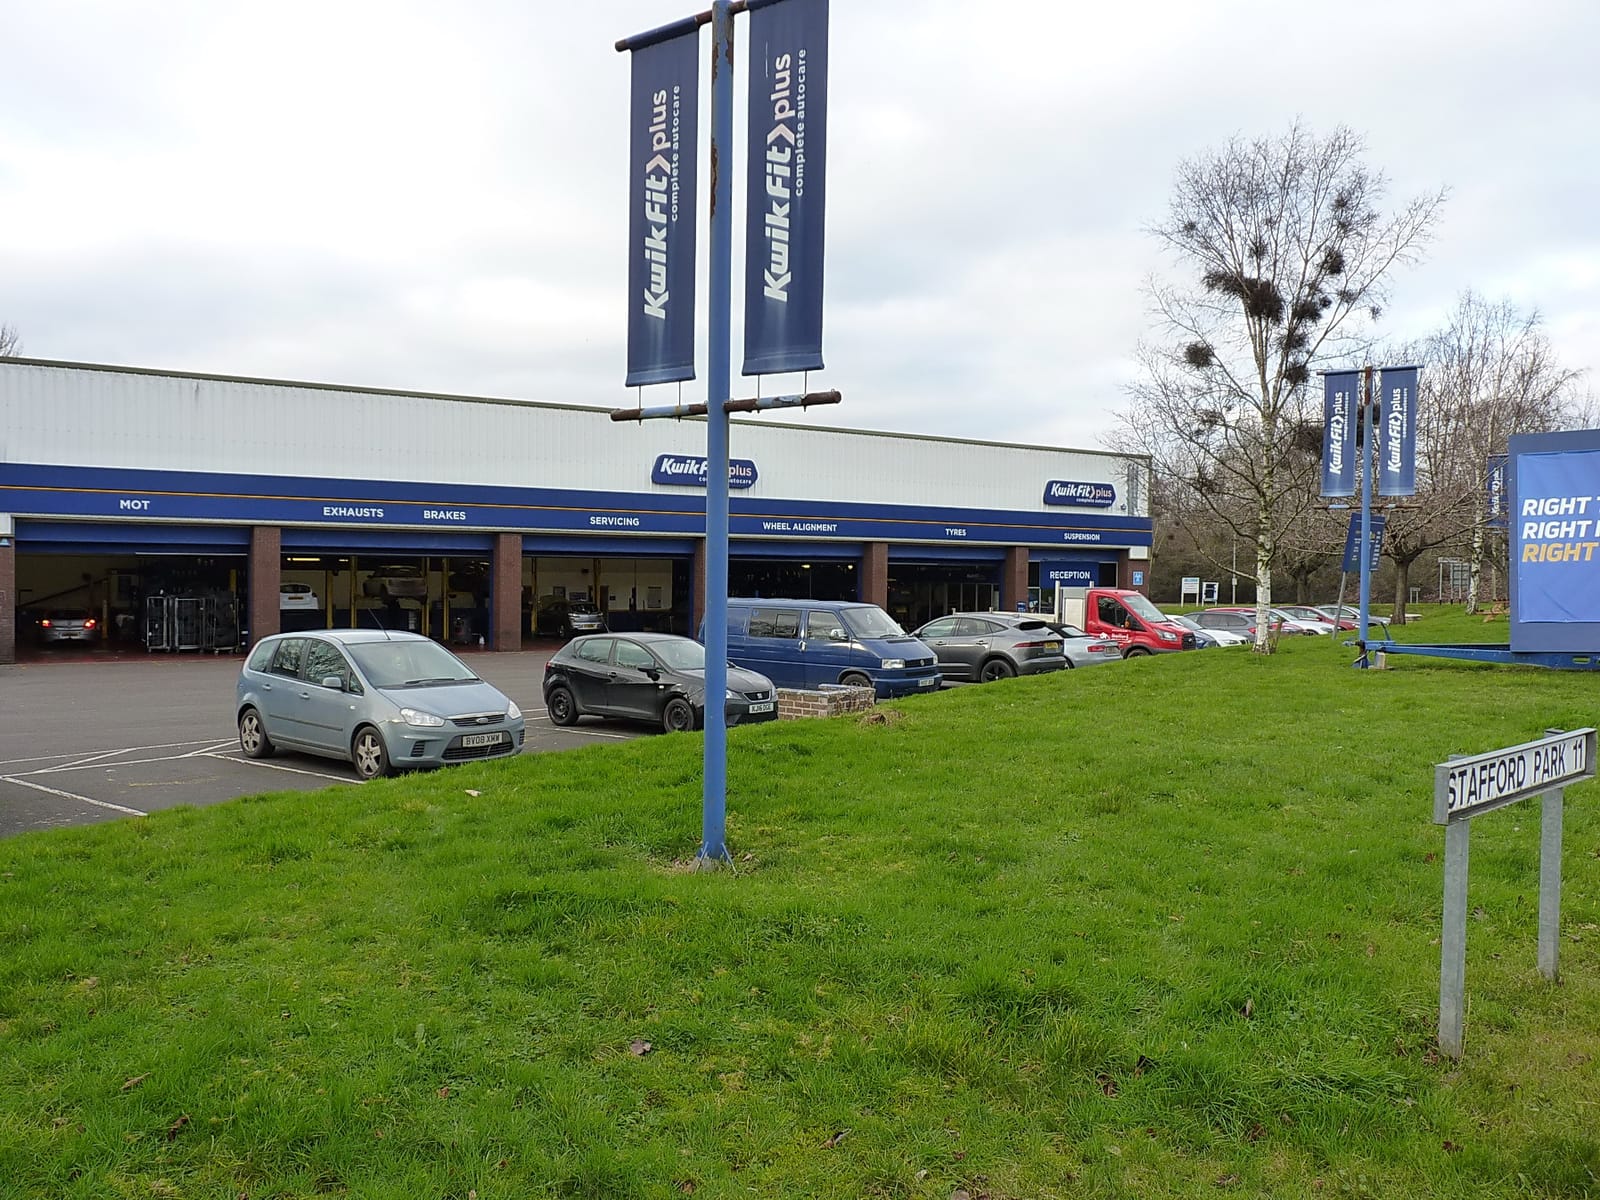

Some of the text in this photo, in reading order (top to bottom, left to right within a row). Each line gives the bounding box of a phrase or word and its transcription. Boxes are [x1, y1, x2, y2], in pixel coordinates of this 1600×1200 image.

[771, 53, 795, 120] plus
[649, 89, 671, 151] plus
[795, 49, 807, 197] complete autocare
[671, 85, 680, 222] complete autocare
[1333, 392, 1345, 414] plus
[1391, 388, 1402, 411] plus
[728, 464, 752, 477] plus
[1095, 488, 1112, 498] plus
[120, 500, 150, 510] MOT
[323, 507, 384, 518] EXHAUSTS
[1522, 497, 1592, 516] RIGHT
[423, 510, 466, 520] BRAKES
[590, 516, 640, 526] SERVICING
[762, 522, 837, 532] WHEEL ALIGNMENT
[945, 528, 967, 537] TYRES
[1522, 520, 1592, 539] RIGHT
[1063, 532, 1101, 541] SUSPENSION
[1522, 542, 1599, 562] RIGHT
[1050, 571, 1091, 579] RECEPTION
[1449, 738, 1584, 809] STAFFORD PARK 11
